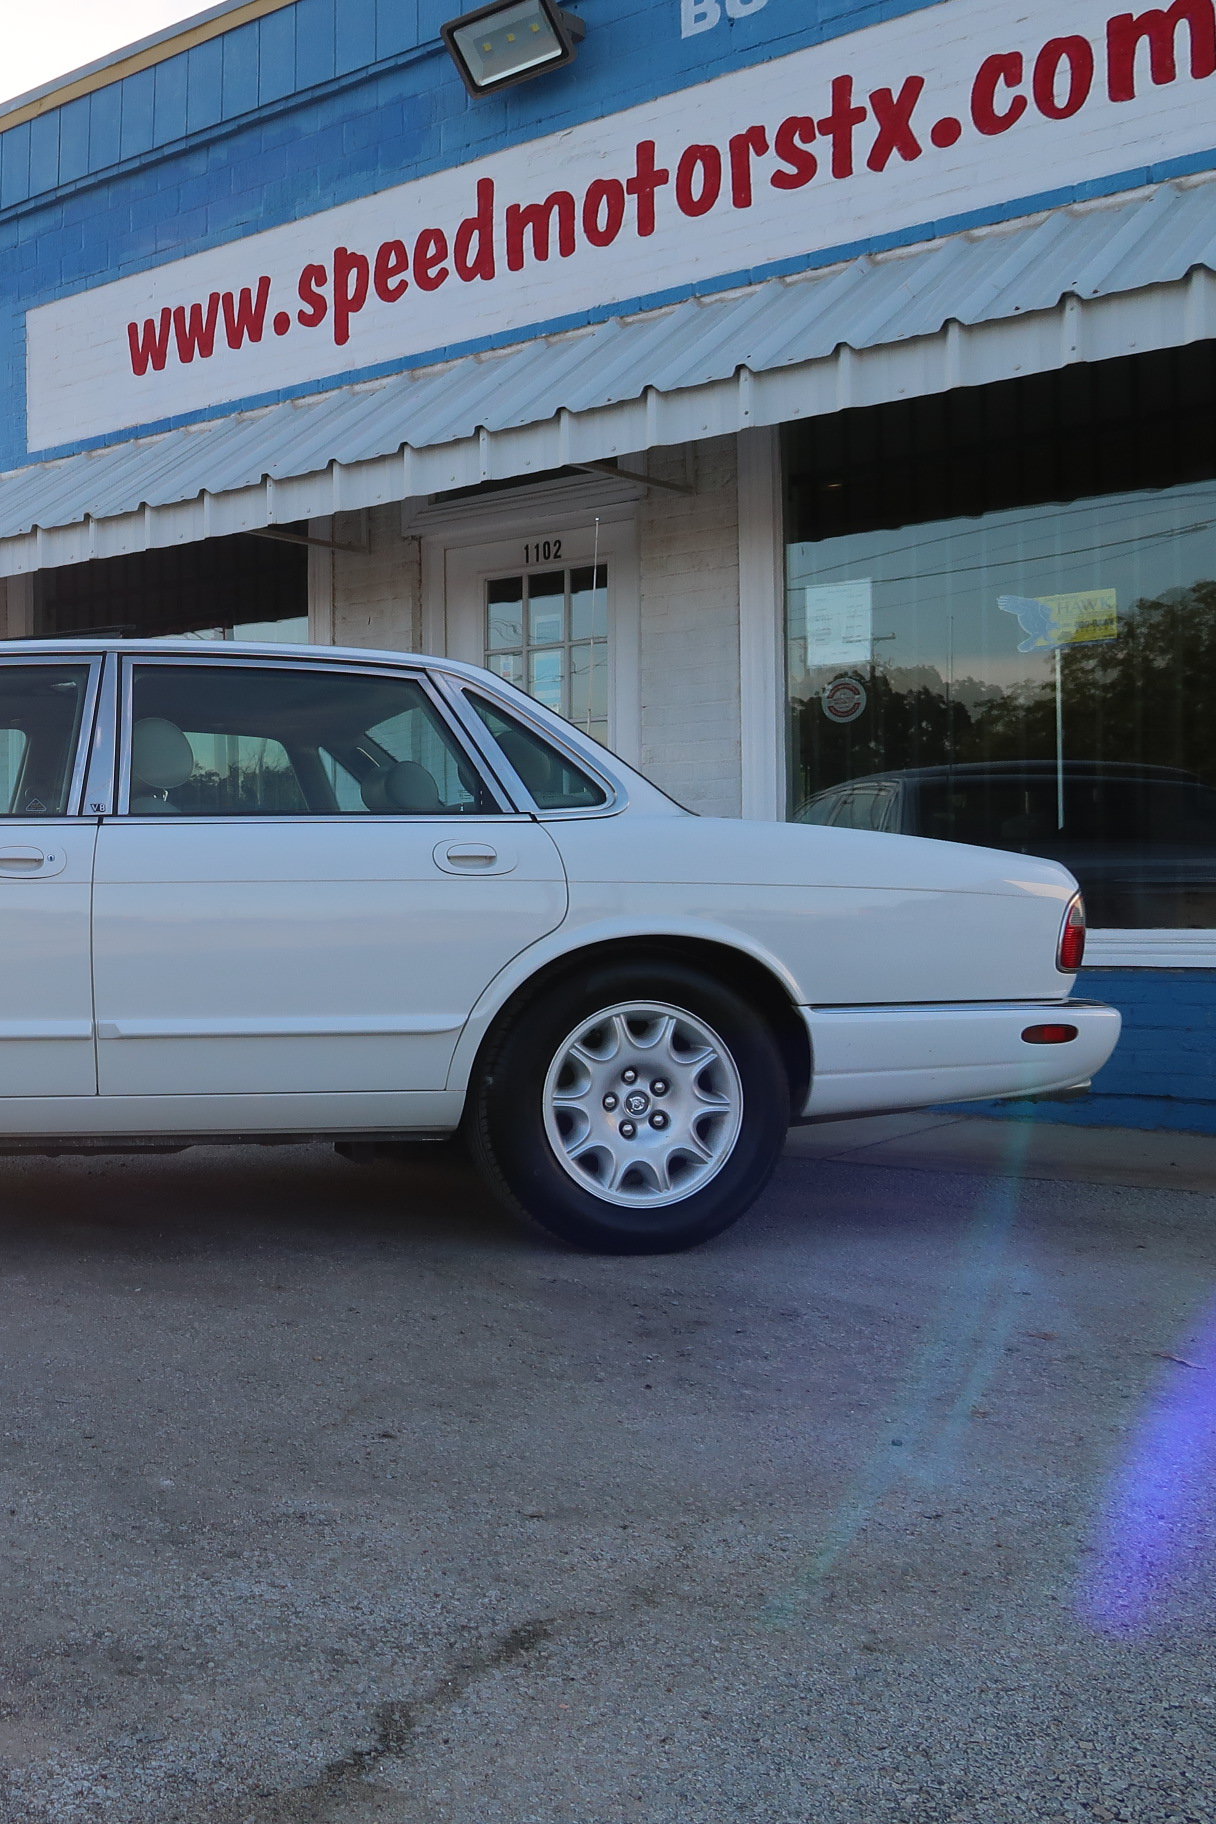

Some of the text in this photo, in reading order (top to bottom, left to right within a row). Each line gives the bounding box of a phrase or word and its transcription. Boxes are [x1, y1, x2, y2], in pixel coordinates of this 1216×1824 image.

[127, 0, 1216, 377] www.speedmotorstx.com
[524, 539, 562, 564] 1102
[90, 803, 106, 813] V8
